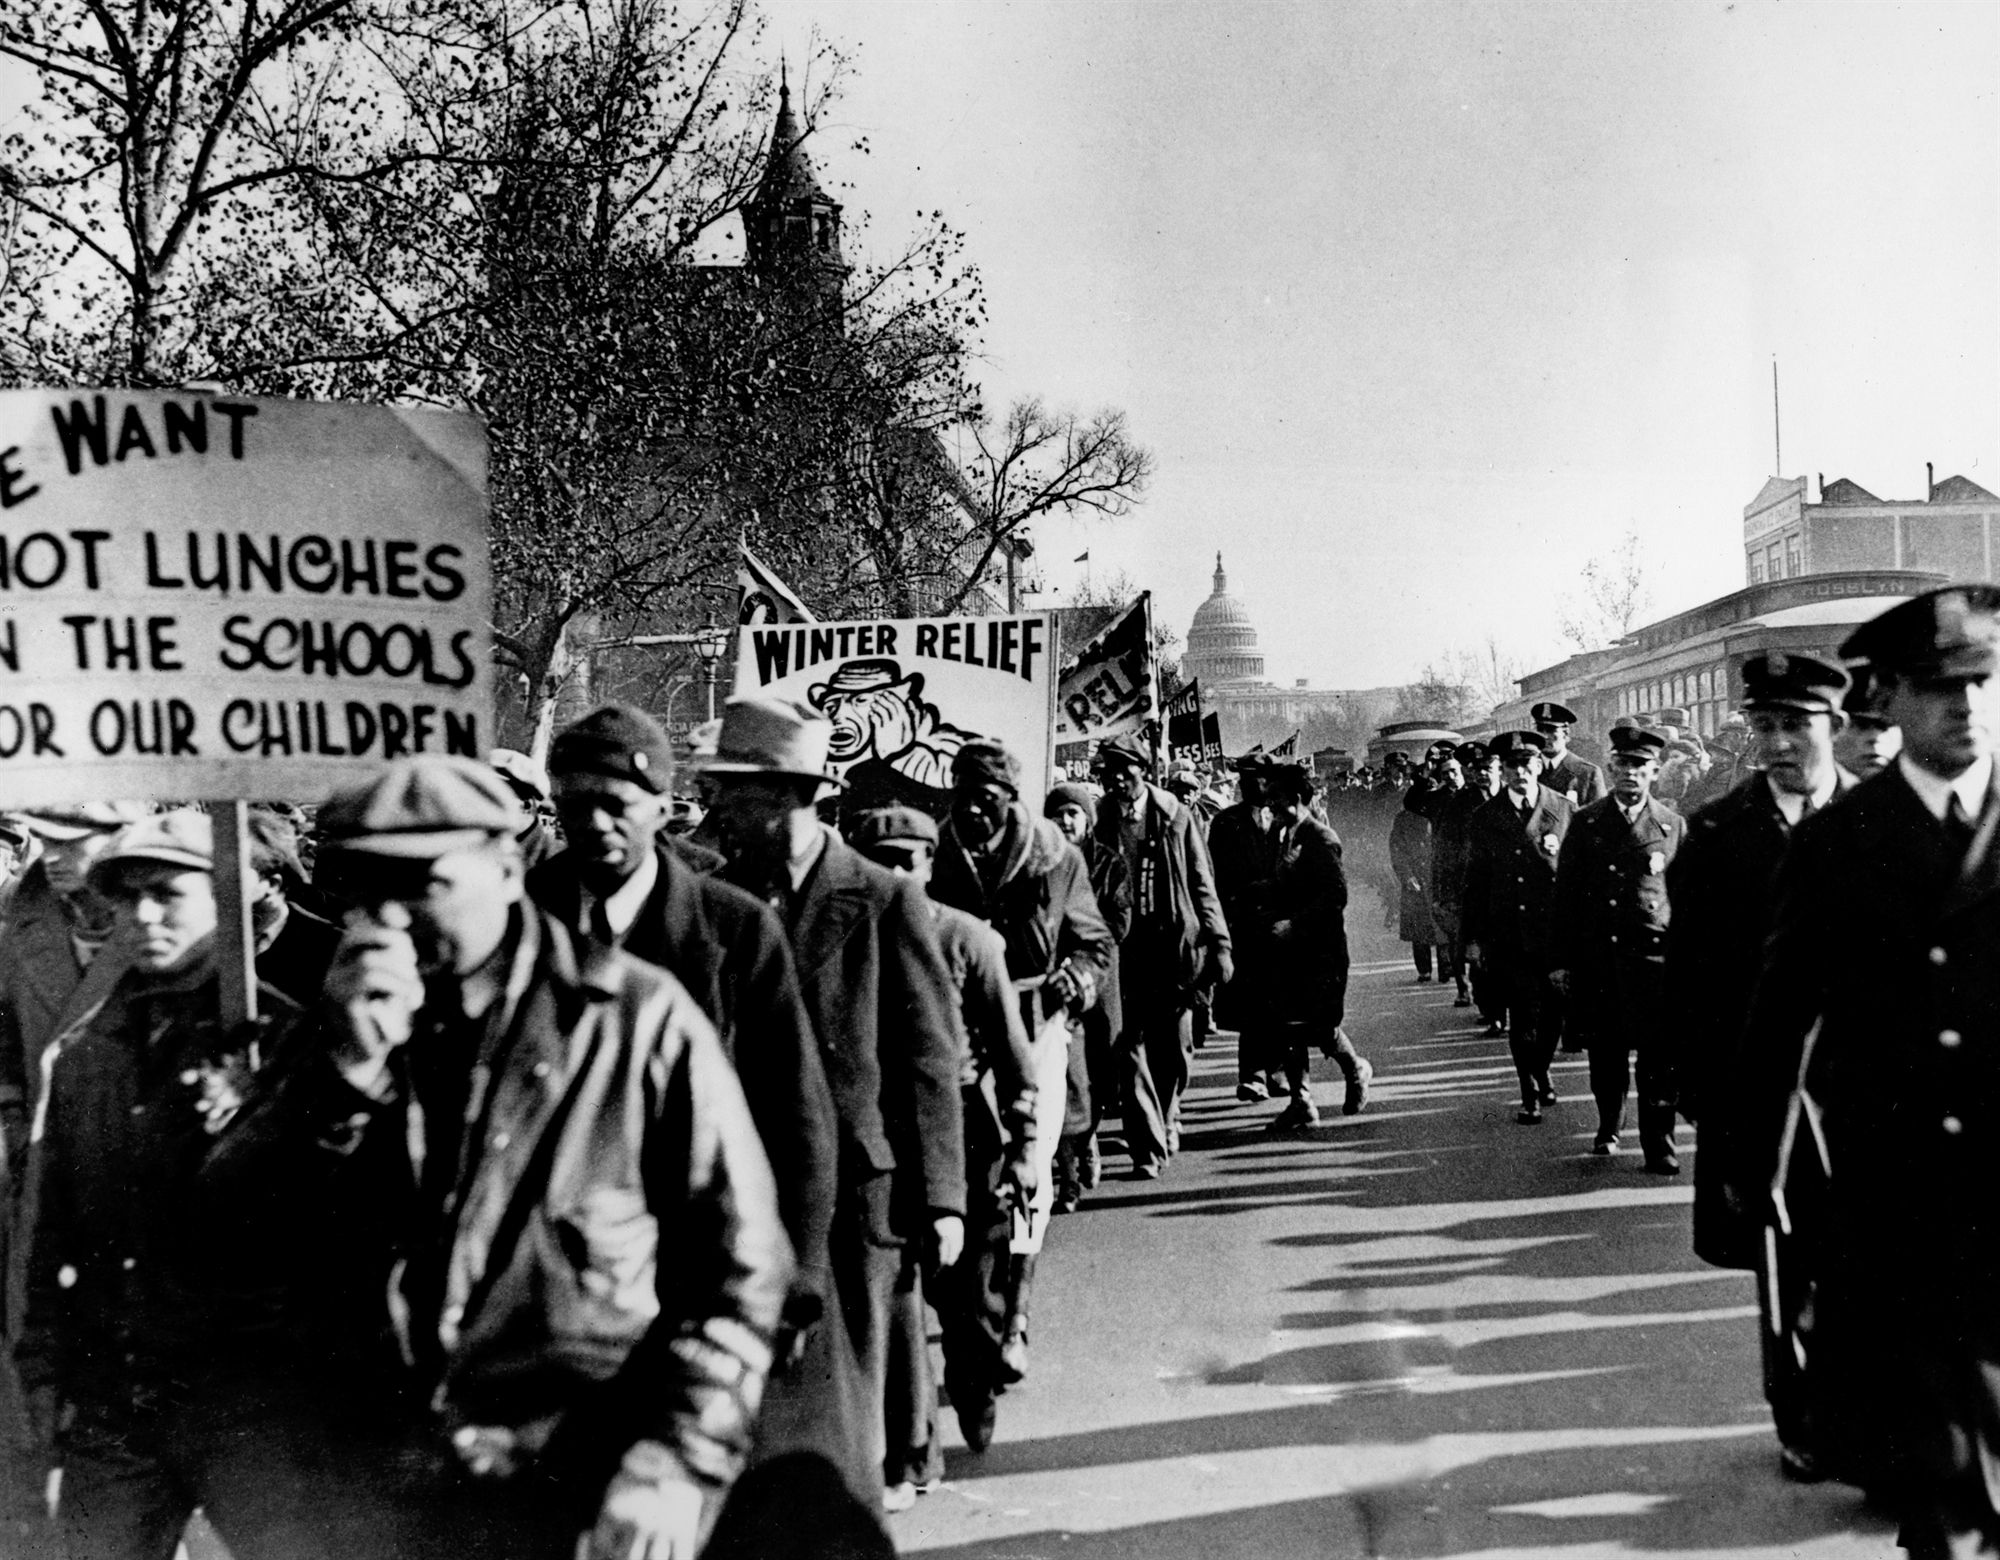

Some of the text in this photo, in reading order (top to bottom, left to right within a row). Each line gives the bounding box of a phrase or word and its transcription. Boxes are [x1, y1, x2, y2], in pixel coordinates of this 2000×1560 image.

[51, 394, 259, 476] WANT
[145, 531, 466, 603] LUNCHES
[61, 615, 183, 672] THE
[219, 614, 476, 688] SCHOOLS
[752, 619, 1043, 687] WINTER RELIEF
[90, 698, 199, 756] OUR
